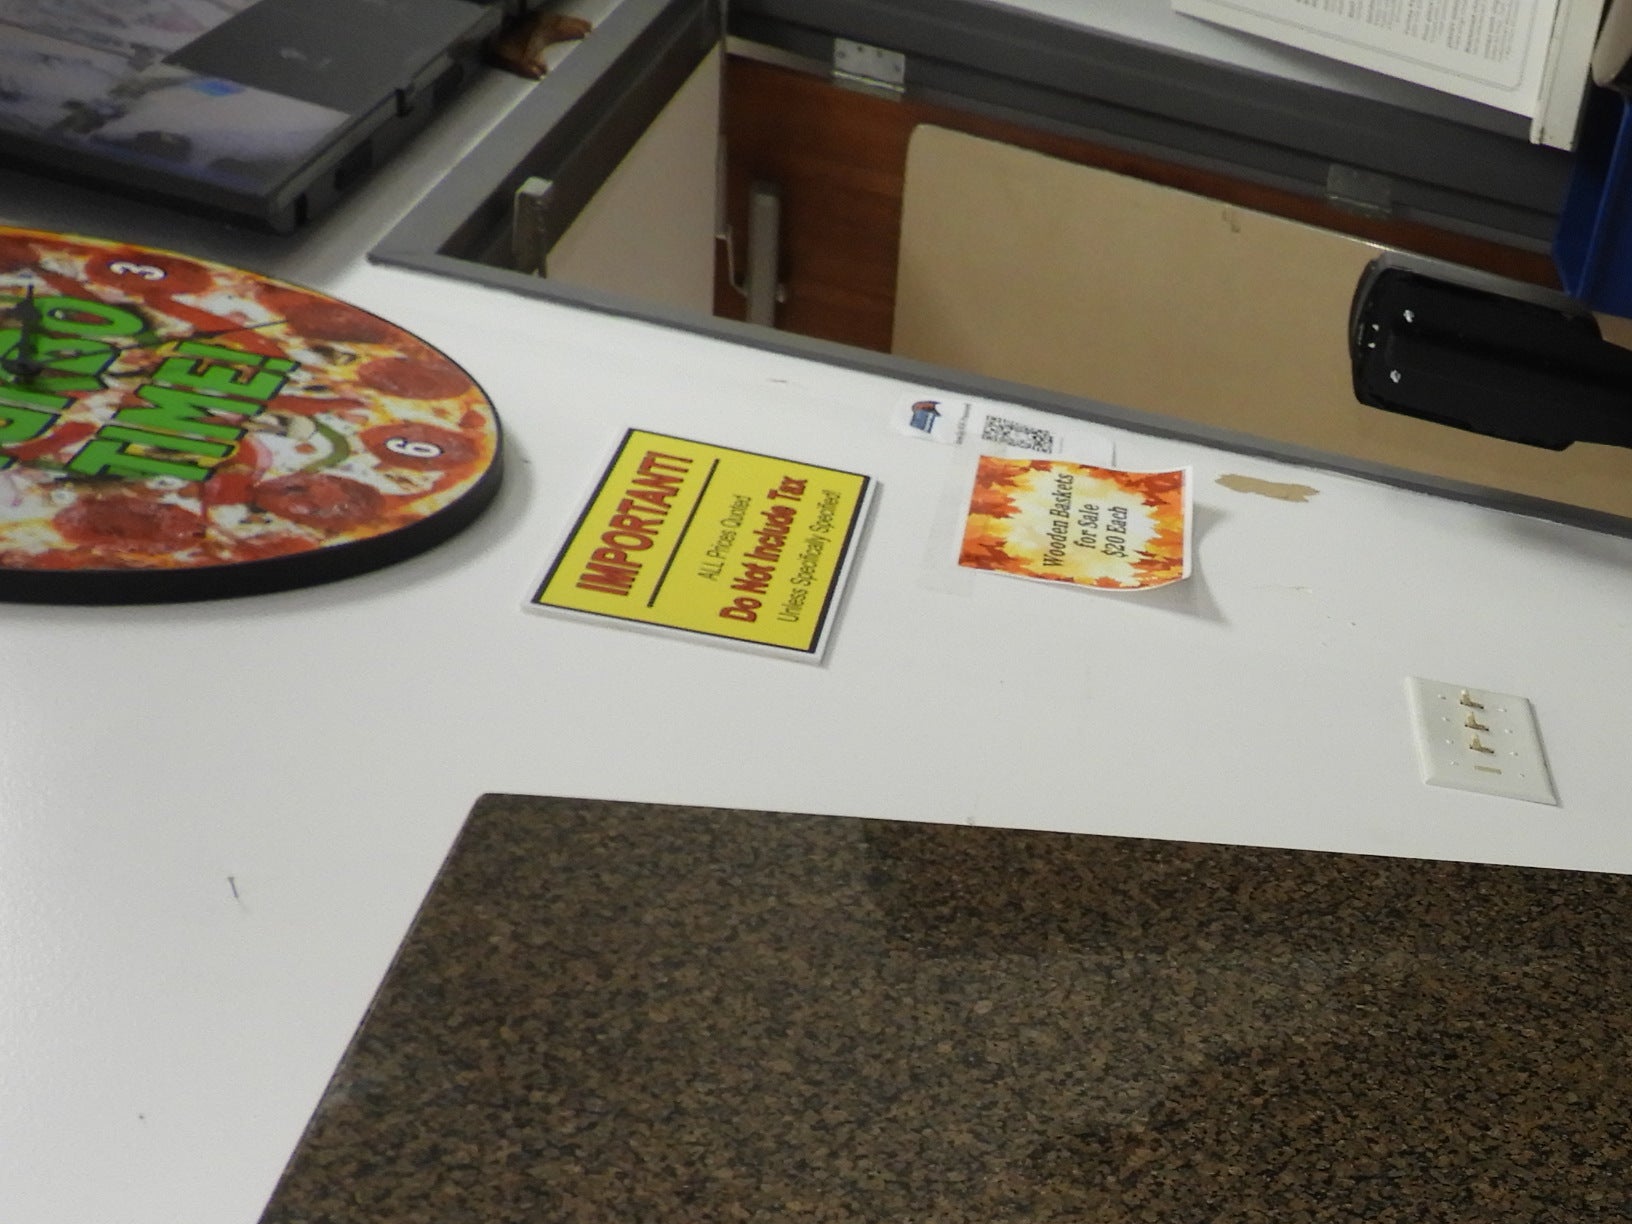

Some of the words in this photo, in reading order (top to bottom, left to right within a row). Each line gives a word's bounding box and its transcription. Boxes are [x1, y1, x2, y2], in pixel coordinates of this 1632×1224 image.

[107, 261, 170, 283] 3
[64, 338, 301, 481] TIME!
[385, 436, 444, 459] 6
[766, 475, 807, 502] Tax
[1049, 473, 1074, 519] Baskets
[575, 450, 694, 597] IMPORTANT!
[720, 494, 752, 527] Quoted
[807, 489, 841, 534] Specified!
[1078, 504, 1101, 529] Sale
[1105, 506, 1128, 534] Each
[706, 530, 736, 557] Prices
[743, 505, 798, 562] Include
[1042, 519, 1071, 567] Wooden
[1073, 529, 1097, 550] for
[1101, 535, 1130, 558] $20
[697, 559, 724, 581] ALL
[789, 534, 829, 587] Specifically
[730, 562, 776, 595] Not
[718, 598, 762, 622] Do
[778, 588, 808, 622] Unless
